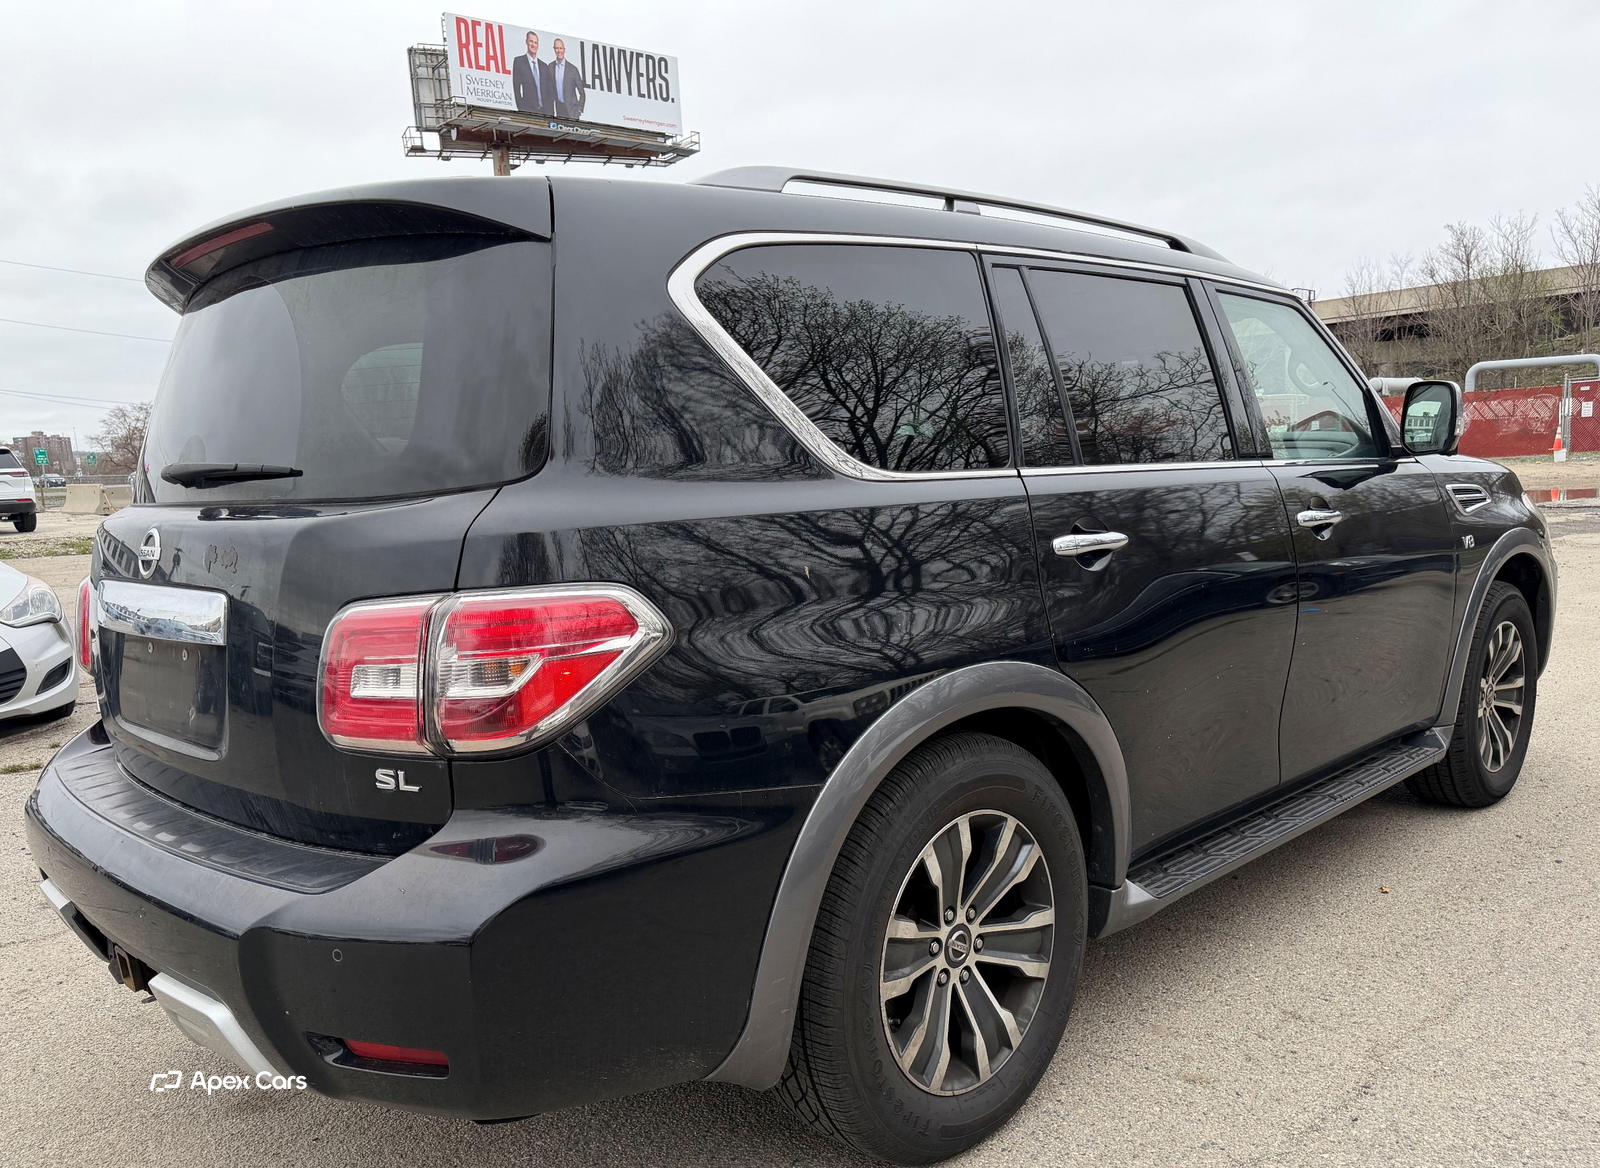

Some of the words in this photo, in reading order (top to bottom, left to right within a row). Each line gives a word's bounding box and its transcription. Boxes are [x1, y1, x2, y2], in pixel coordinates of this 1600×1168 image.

[455, 16, 512, 75] REAL
[579, 41, 675, 103] LAWYERS.
[466, 87, 513, 100] MERRIGAN
[1461, 534, 1476, 549] V8
[375, 768, 421, 792] SL
[862, 1016, 932, 1139] Firestone
